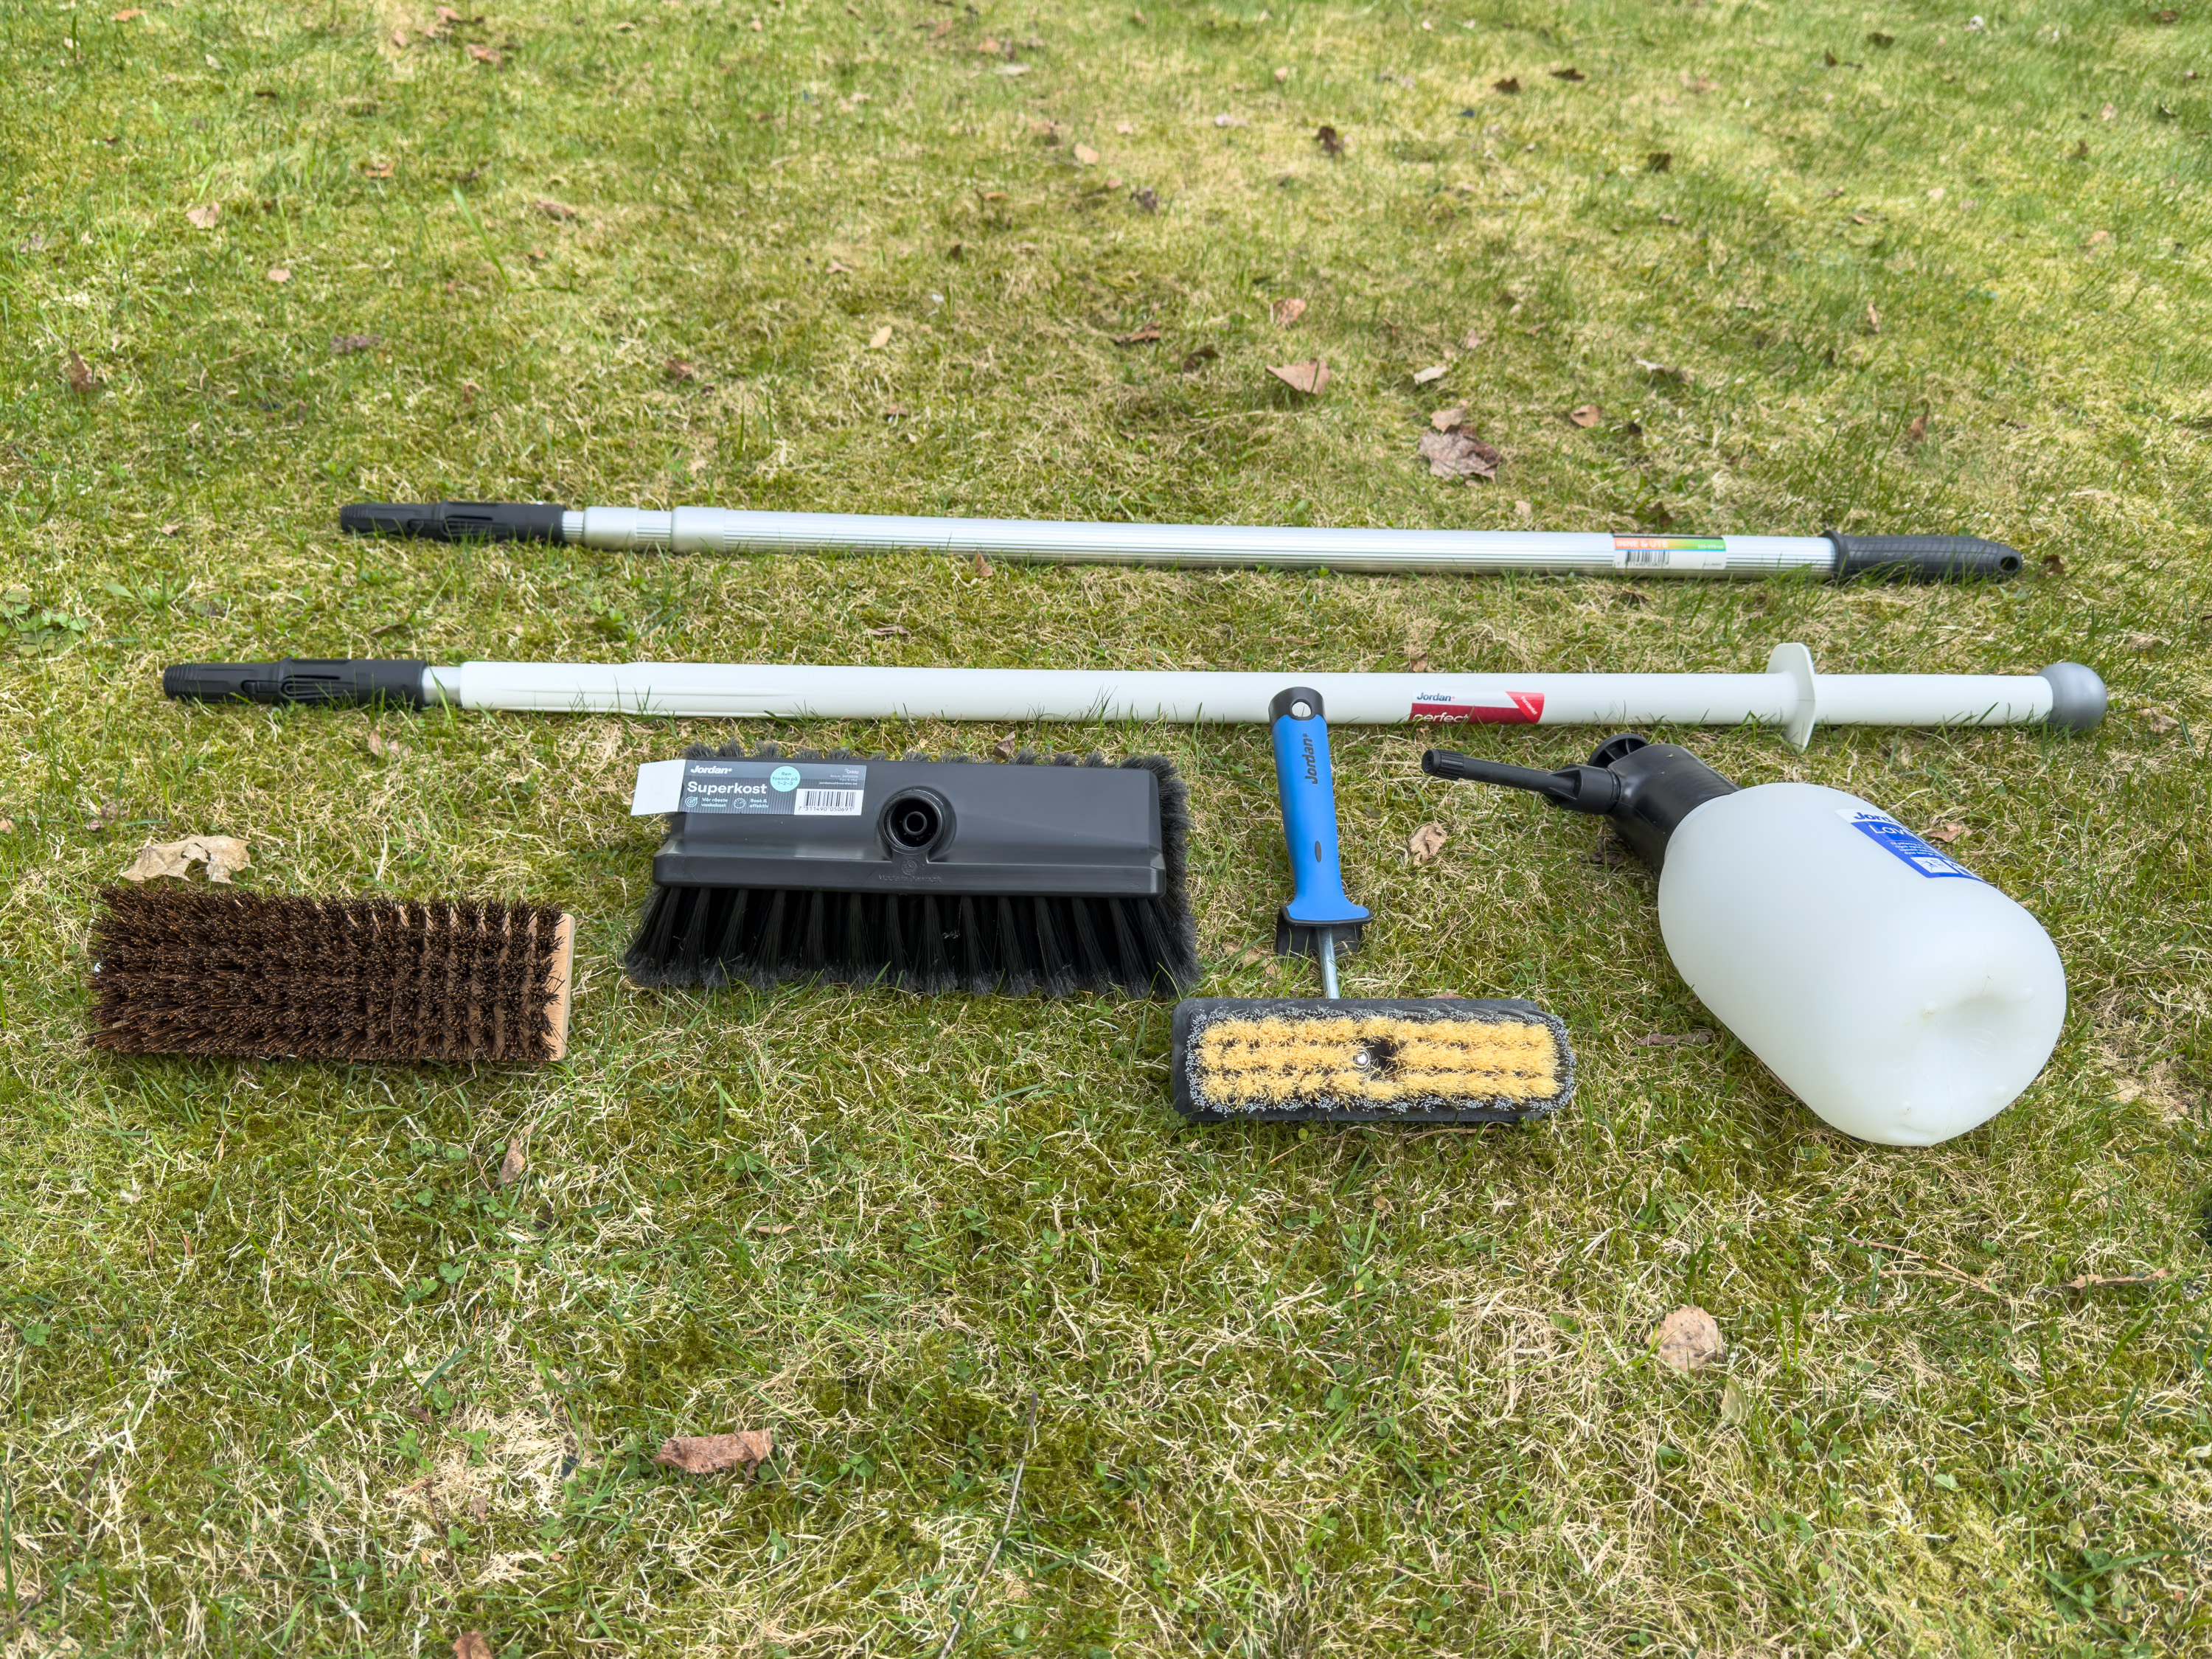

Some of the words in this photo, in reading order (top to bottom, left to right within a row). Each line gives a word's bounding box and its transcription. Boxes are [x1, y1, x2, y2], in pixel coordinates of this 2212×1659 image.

[1616, 539, 1639, 548] INNE
[1641, 539, 1649, 548] &
[1649, 540, 1669, 549] UTE
[1416, 692, 1451, 702] Jordan
[1302, 738, 1318, 785] Jordan
[690, 765, 729, 774] Jordan
[687, 781, 768, 796] Superkost
